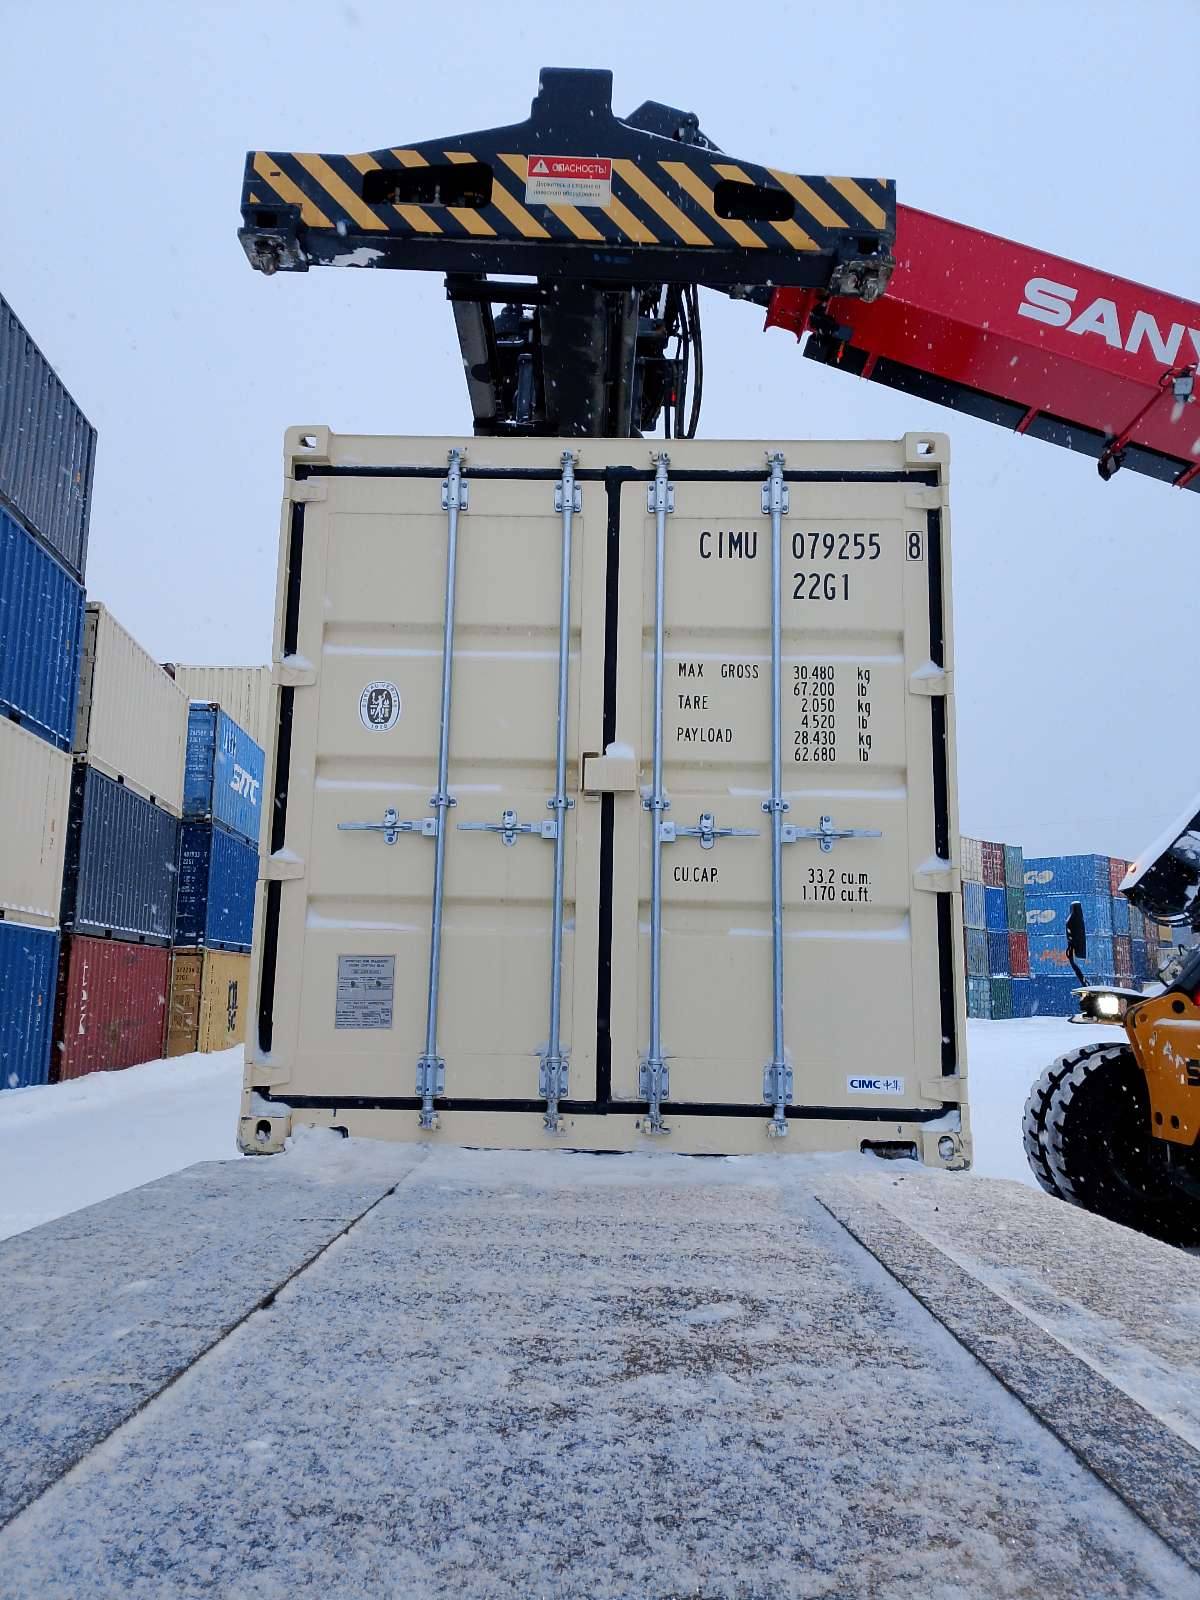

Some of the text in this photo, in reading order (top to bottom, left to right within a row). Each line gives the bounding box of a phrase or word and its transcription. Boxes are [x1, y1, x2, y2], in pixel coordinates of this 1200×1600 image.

[552, 163, 607, 174] ОПАСНОСТЬ!
[699, 531, 921, 560] CIMU 079255 8
[792, 573, 849, 600] 22G1
[678, 663, 870, 684] MAX GROSS 30.480 kg
[793, 682, 867, 696] 67.200 lb
[678, 695, 871, 717] TARE 2.050 kg
[801, 715, 868, 729] 4.520 lb
[677, 727, 872, 749] PAYLOAD 28.430 kg
[794, 747, 869, 762] 62.680 lb
[807, 869, 836, 884] 33.2
[840, 872, 872, 885] cu.m.
[802, 885, 873, 902] 1.170 cu.ft.
[850, 1079, 881, 1089] CIMC
